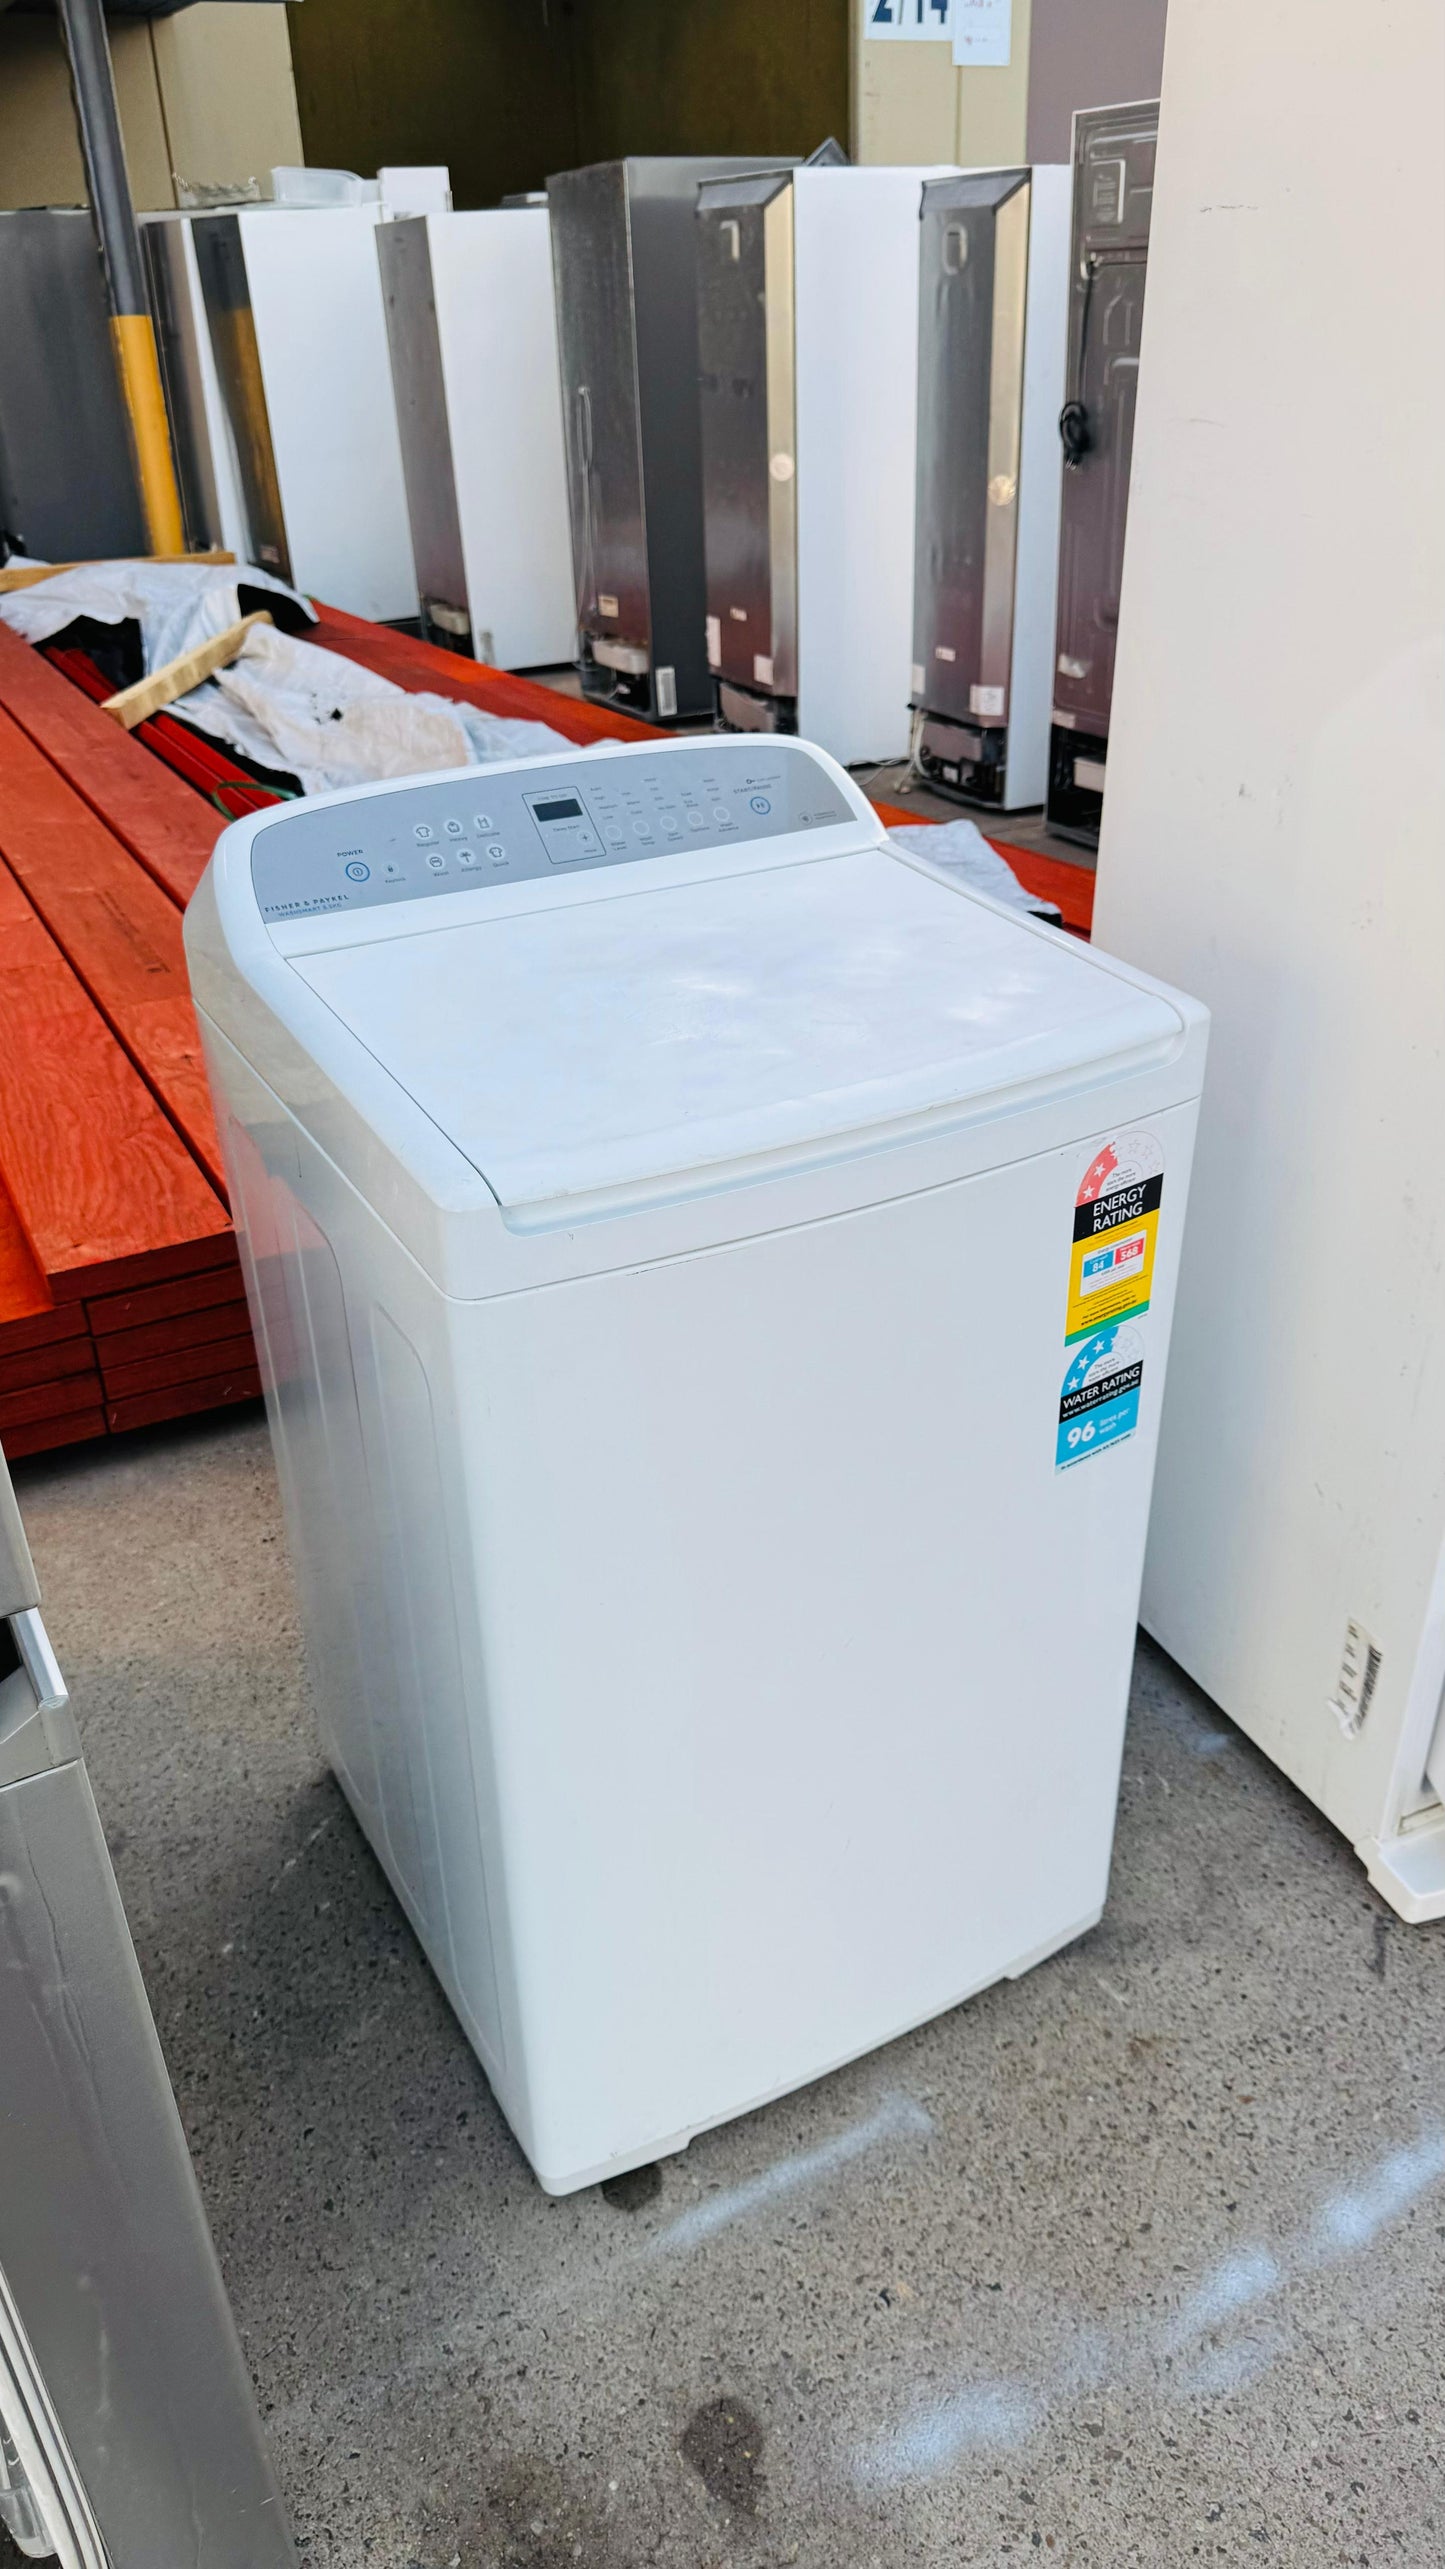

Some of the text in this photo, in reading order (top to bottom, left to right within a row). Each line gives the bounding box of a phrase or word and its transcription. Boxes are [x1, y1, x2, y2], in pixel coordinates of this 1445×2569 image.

[337, 849, 363, 857] POWER
[265, 902, 300, 913] FISHER
[313, 894, 350, 905] PAYKEL
[1094, 1184, 1147, 1217] ENERGY
[1093, 1202, 1143, 1233] RATING
[1093, 1260, 1105, 1273] 84
[1121, 1246, 1139, 1261] 568
[1063, 1366, 1140, 1409] WATER RATING
[1063, 1379, 1139, 1418] www.waterrating.gov.au
[1067, 1420, 1096, 1449] 96
